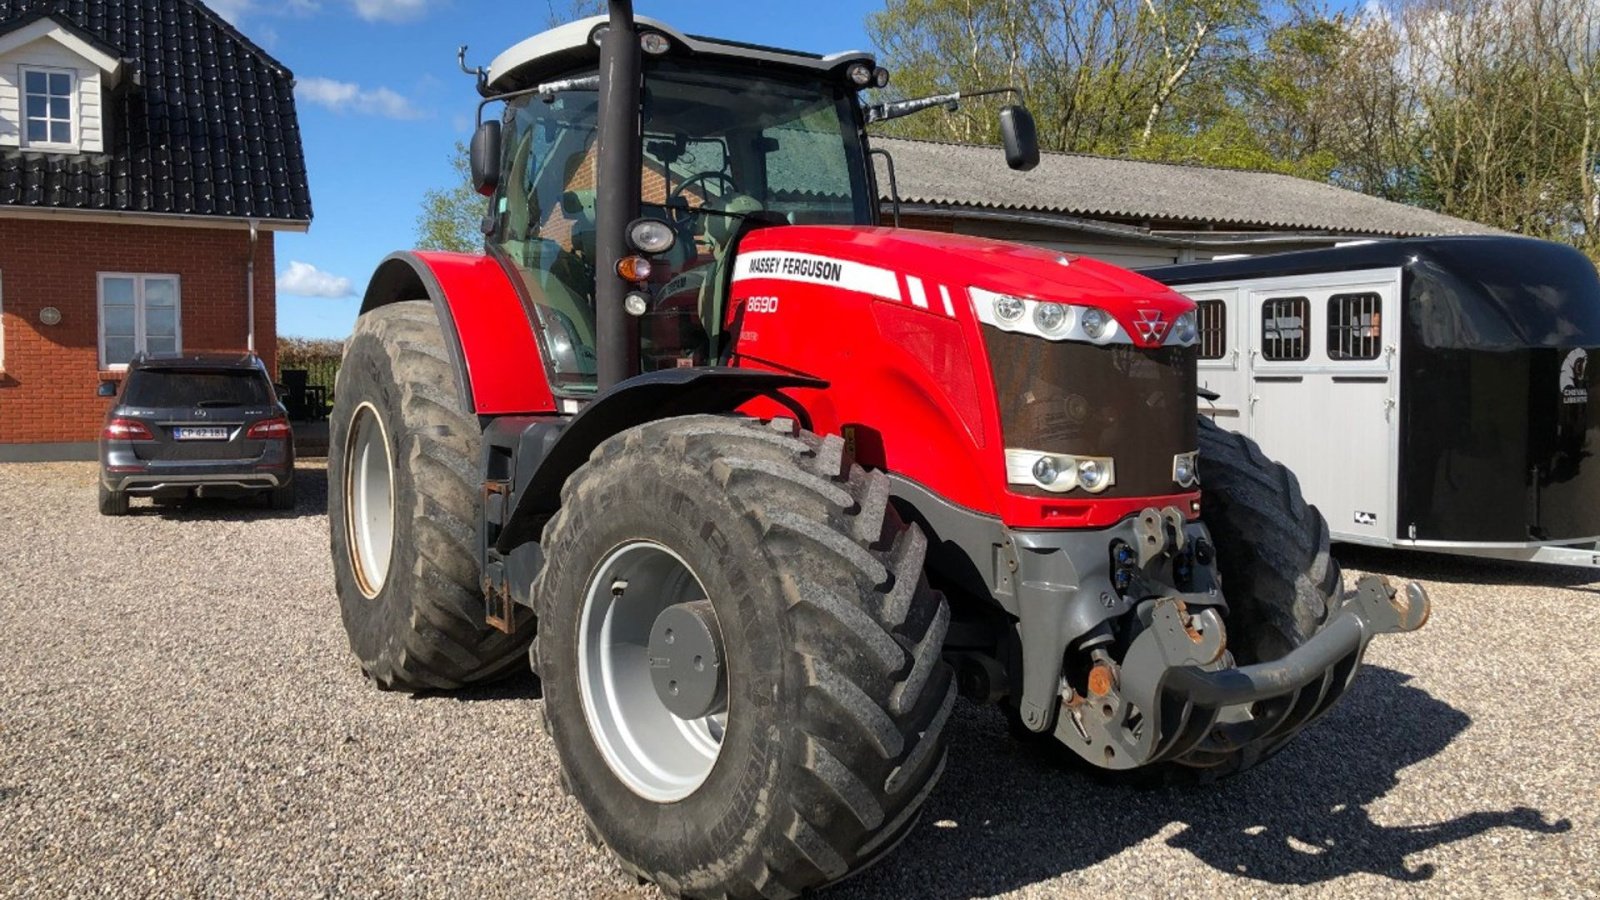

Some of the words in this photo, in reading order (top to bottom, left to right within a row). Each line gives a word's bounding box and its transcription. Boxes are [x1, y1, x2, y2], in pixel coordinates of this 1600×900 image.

[749, 258, 781, 274] MASSEY
[782, 258, 842, 281] FERGUSON
[747, 297, 778, 312] 8690
[181, 428, 194, 437] CP
[195, 428, 207, 437] 42
